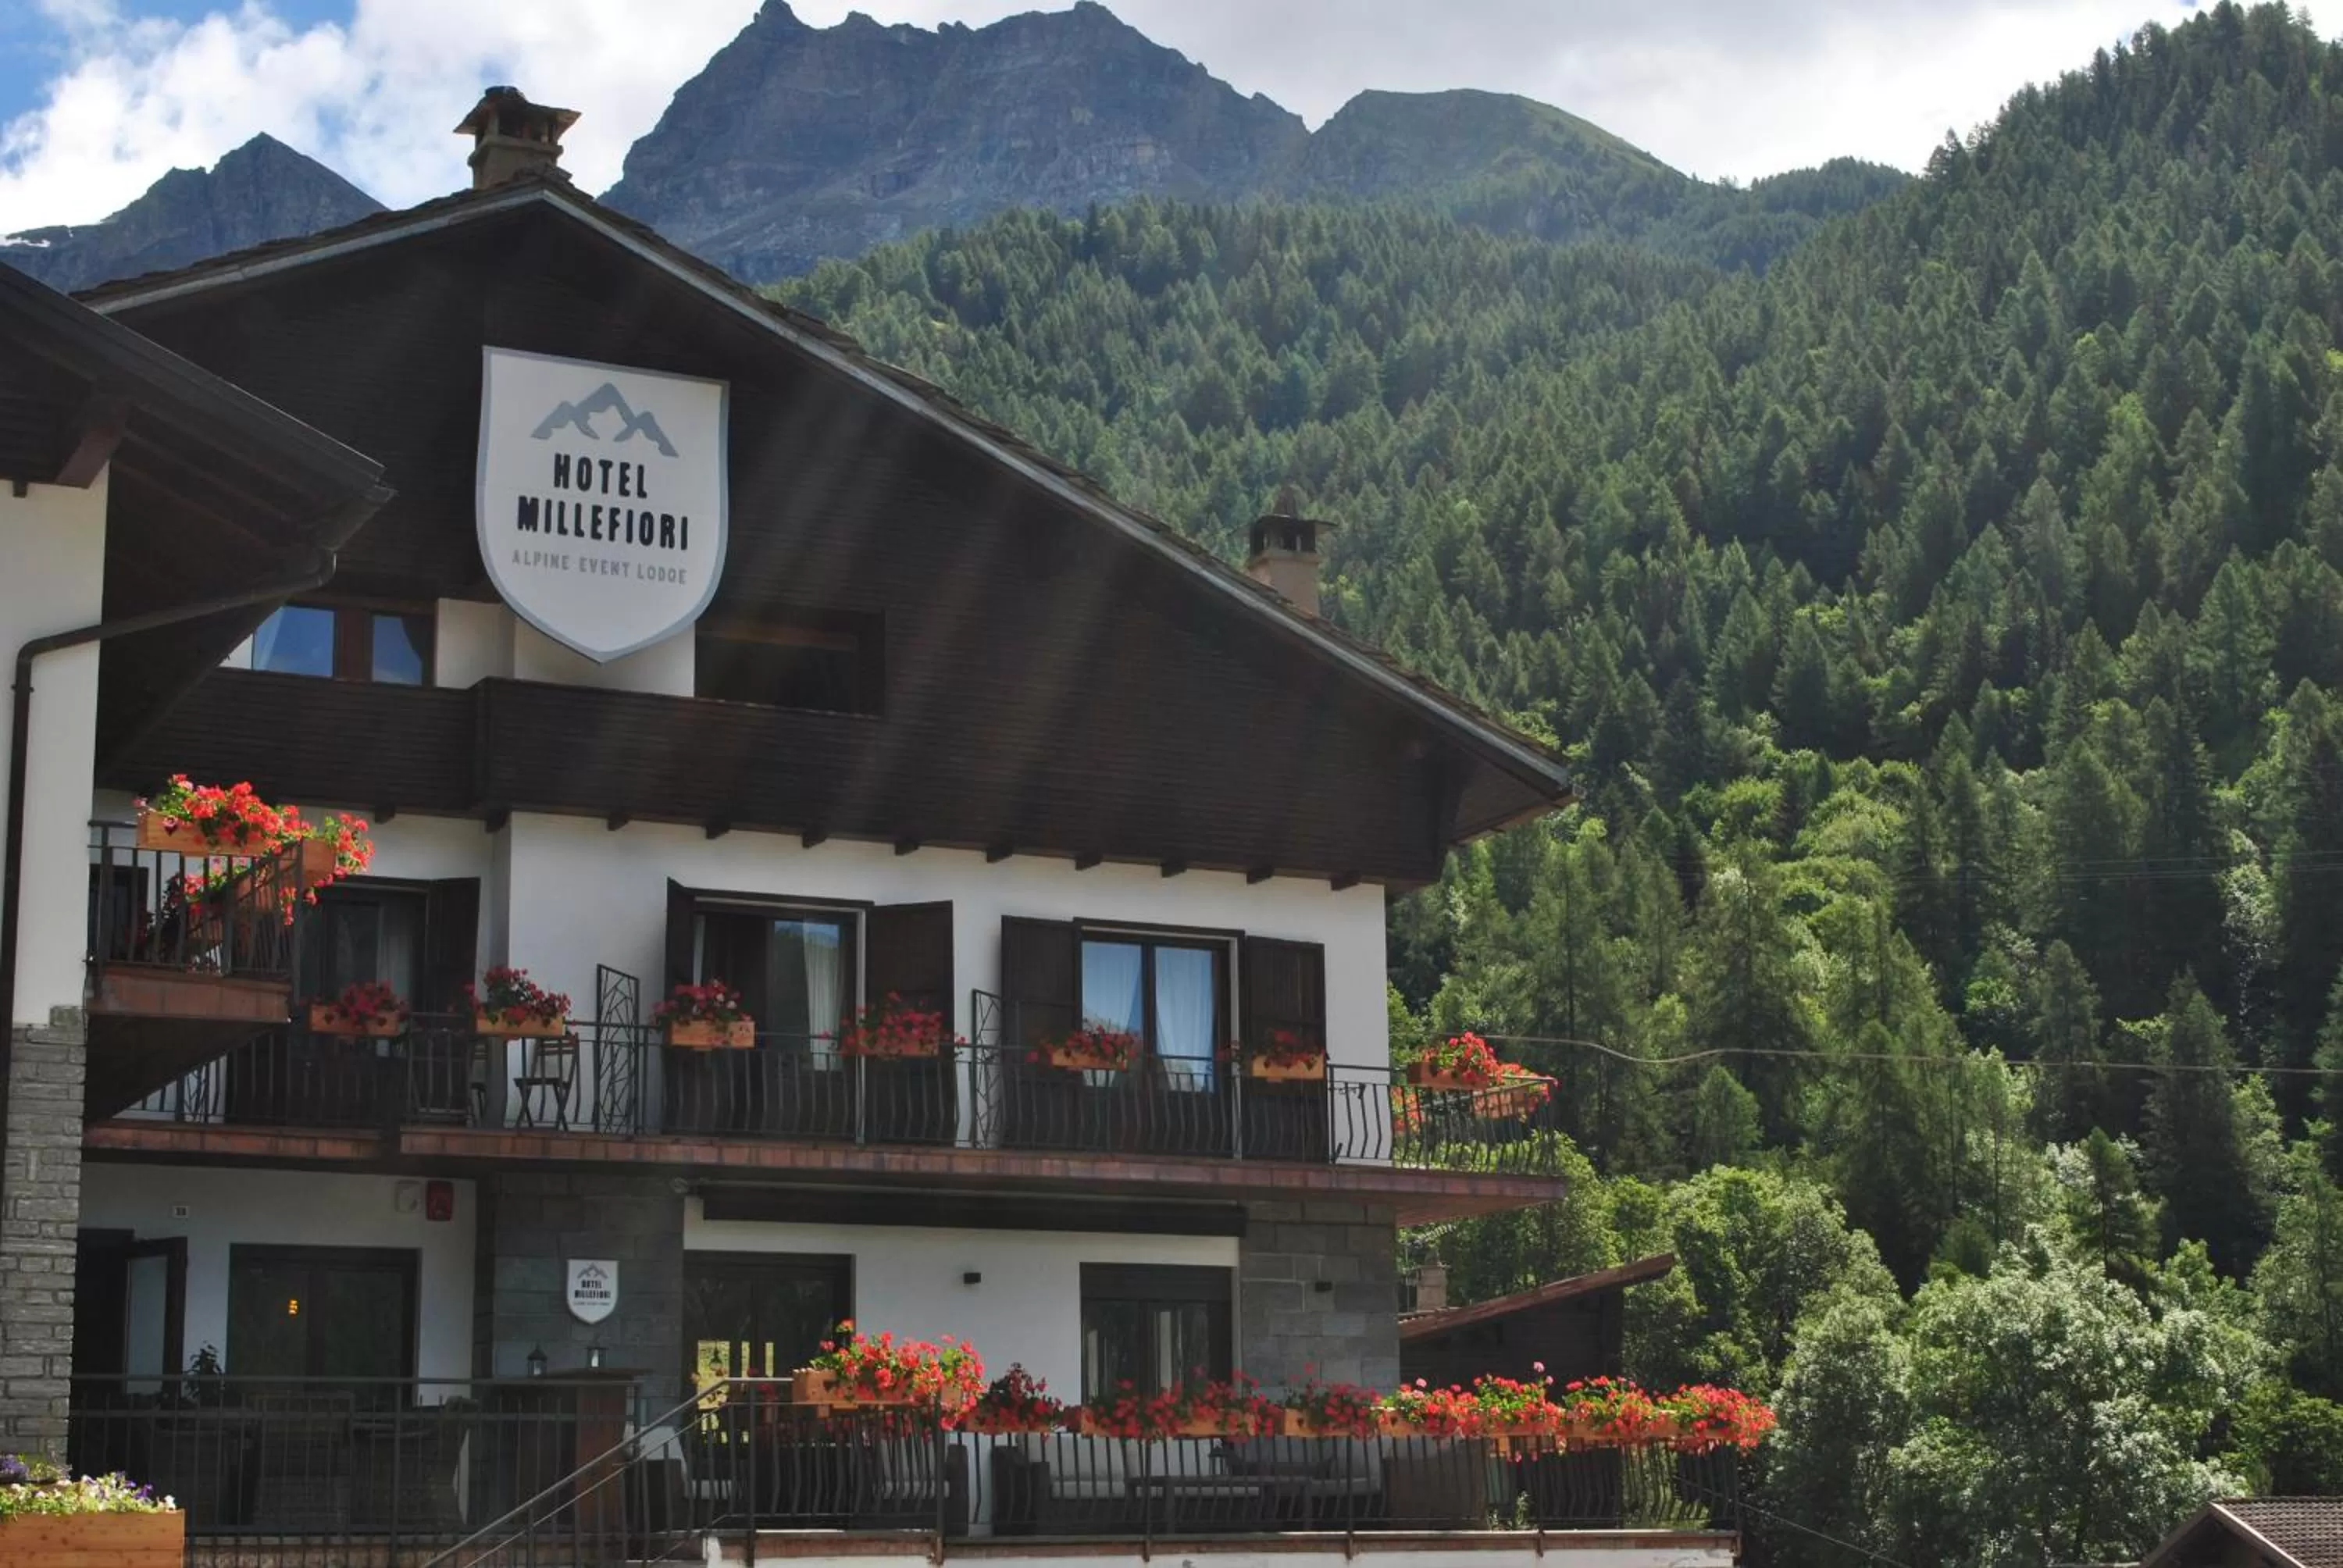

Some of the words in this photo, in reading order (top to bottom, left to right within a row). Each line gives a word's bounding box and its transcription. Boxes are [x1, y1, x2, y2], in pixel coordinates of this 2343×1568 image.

[553, 452, 648, 499] HOTEL
[517, 494, 689, 551] MILLEFIORI
[512, 549, 570, 570] ALPINE
[579, 556, 630, 579] EVENT
[637, 563, 688, 585] LODGE
